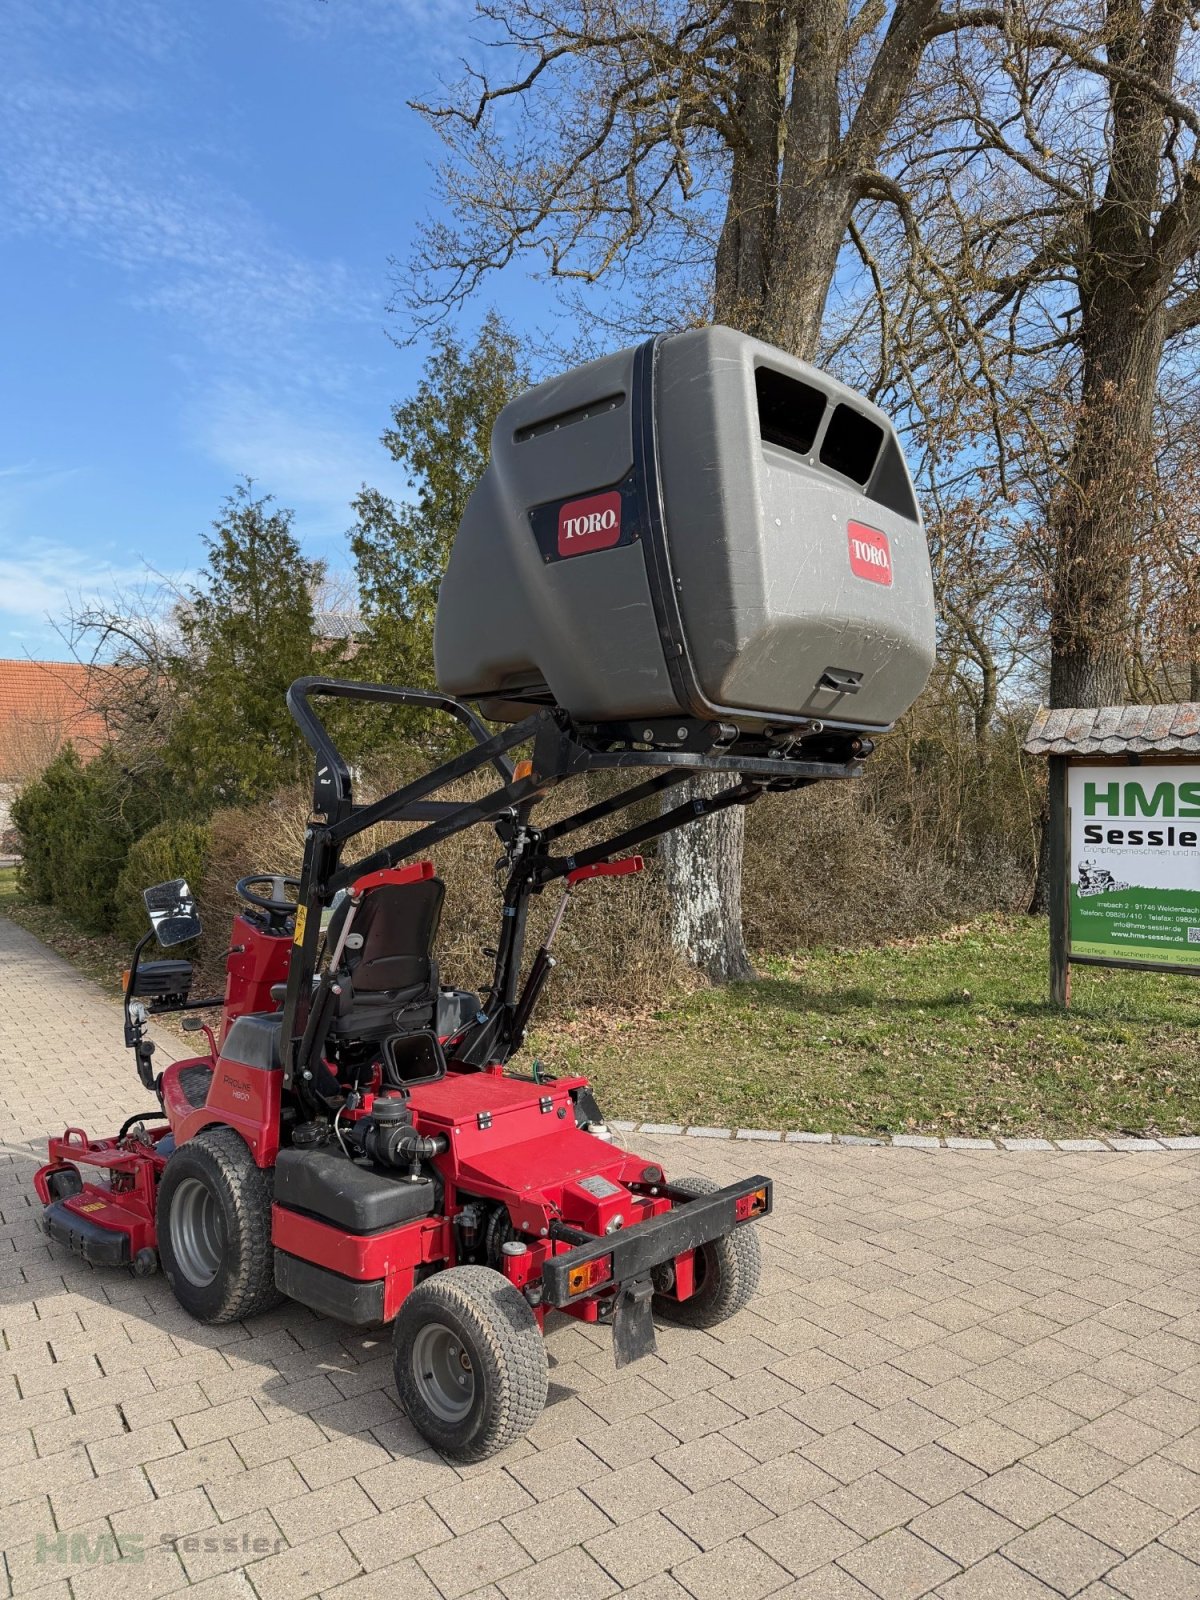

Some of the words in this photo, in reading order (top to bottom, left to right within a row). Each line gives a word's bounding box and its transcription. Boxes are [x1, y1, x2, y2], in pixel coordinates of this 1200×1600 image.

[563, 509, 617, 539] TORO
[851, 538, 888, 569] TORO
[1084, 782, 1200, 817] HMS
[1172, 848, 1189, 857] und
[1079, 908, 1104, 917] Telefon:
[1148, 913, 1174, 922] Telefax:
[1156, 904, 1200, 914] Weidenbach
[1110, 931, 1184, 942] www.hms-sessler.de
